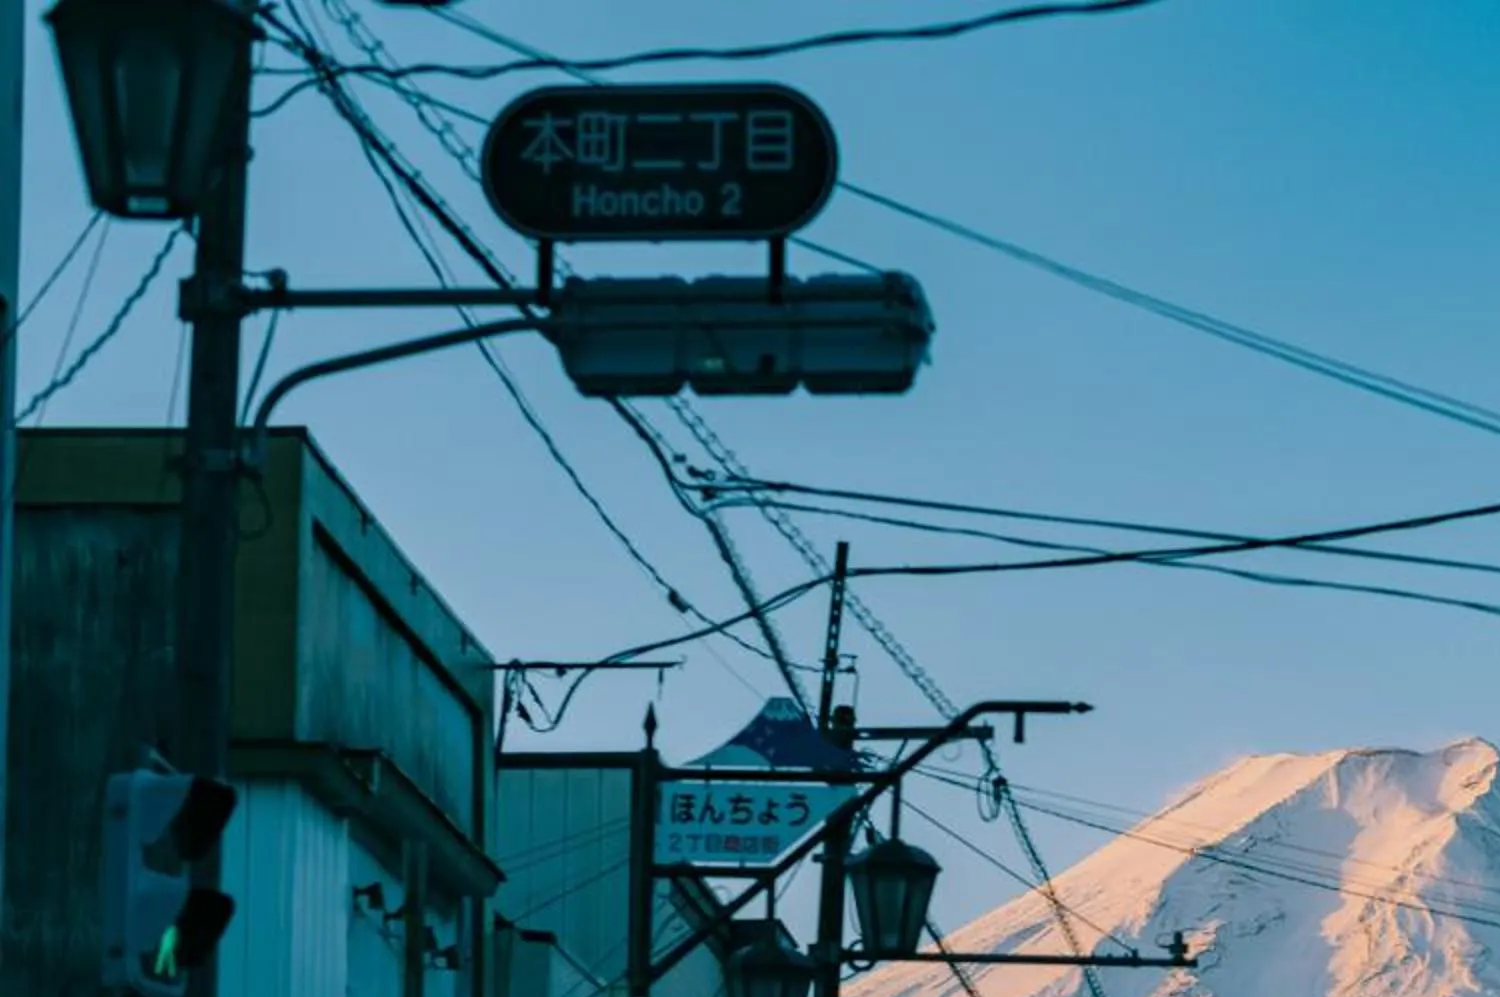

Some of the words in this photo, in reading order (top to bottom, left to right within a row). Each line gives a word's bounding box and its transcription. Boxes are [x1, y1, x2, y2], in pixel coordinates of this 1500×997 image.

[520, 111, 793, 175] 本町二丁目
[570, 183, 705, 217] Honcho
[720, 183, 743, 216] 2
[671, 793, 810, 825] ほんちょう
